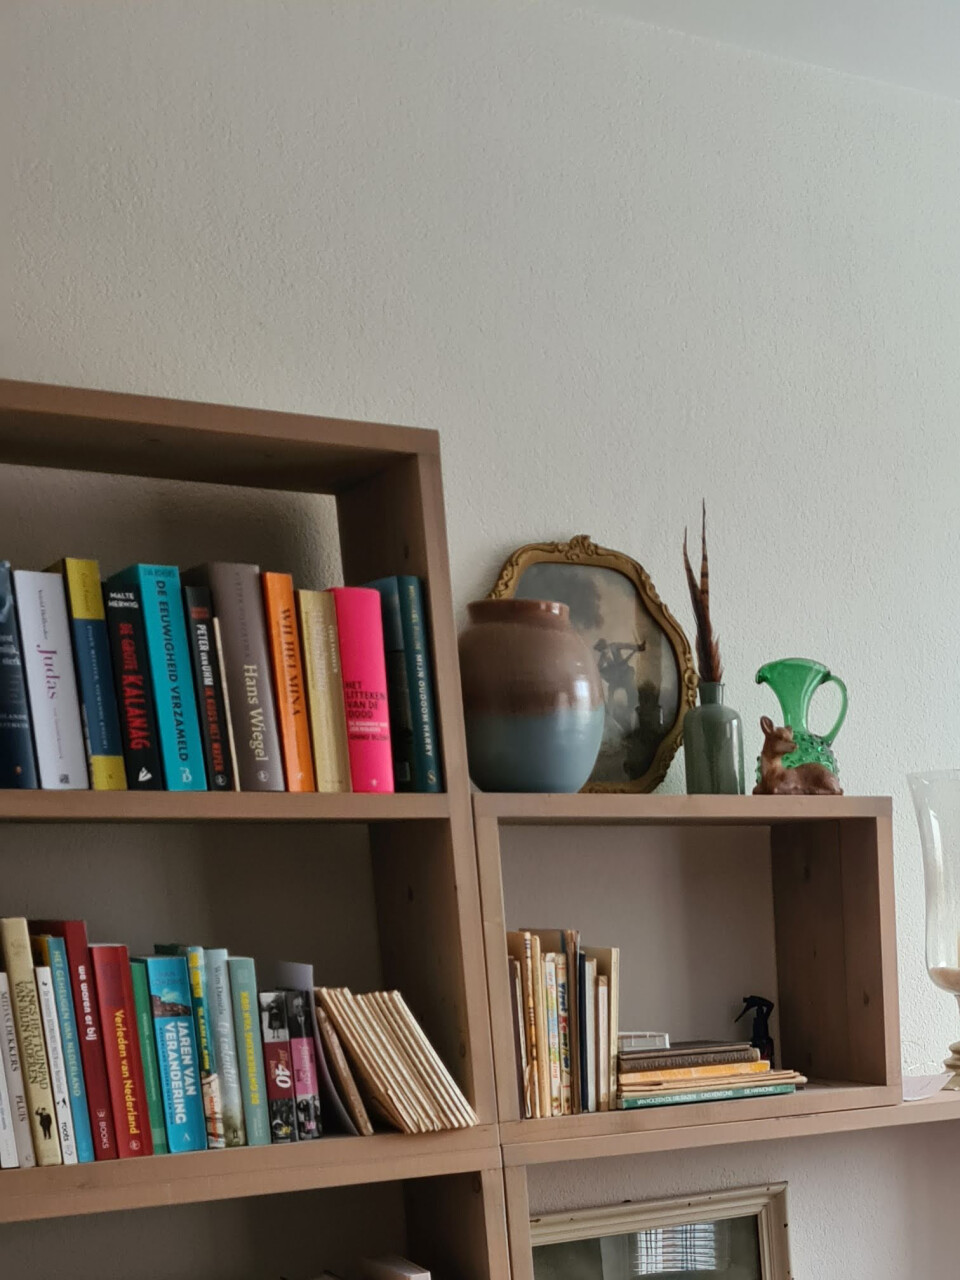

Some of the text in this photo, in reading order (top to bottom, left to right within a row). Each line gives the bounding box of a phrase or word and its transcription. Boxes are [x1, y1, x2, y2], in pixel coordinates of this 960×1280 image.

[108, 600, 138, 608] HERWIG
[110, 592, 134, 600] MALTE
[154, 579, 166, 596] DE
[119, 638, 138, 670] GROTE
[159, 601, 178, 682] EEUWIGHEID
[198, 623, 210, 651] PETER
[37, 644, 61, 699] Judas
[201, 664, 214, 685] UHM
[281, 608, 302, 716] WILHELMINA
[413, 653, 424, 678] MIJN
[121, 675, 152, 750] KALANAG
[170, 686, 189, 762] VERZAMELD
[241, 664, 272, 761] Hans Wiegel
[416, 679, 430, 723] OUDOOM
[421, 724, 434, 756] HARRY
[215, 965, 223, 985] Wim
[52, 950, 81, 1096] HET GEHEUGEN VAN NEDERLAND
[77, 964, 97, 1041] we waren er bij
[4, 1024, 19, 1072] DEKKERS
[13, 980, 39, 1084] VAN MIJN VADEREN
[24, 980, 49, 1091] LANGS HET TUINPAD
[116, 1009, 136, 1134] Verleden van Nederland
[163, 1021, 188, 1124] VERANDERING
[175, 1020, 197, 1096] JAREN VAN
[275, 1064, 291, 1088] 40
[16, 1094, 27, 1123] PLUIS
[60, 1121, 69, 1142] roots
[100, 1120, 108, 1149] BOOKS
